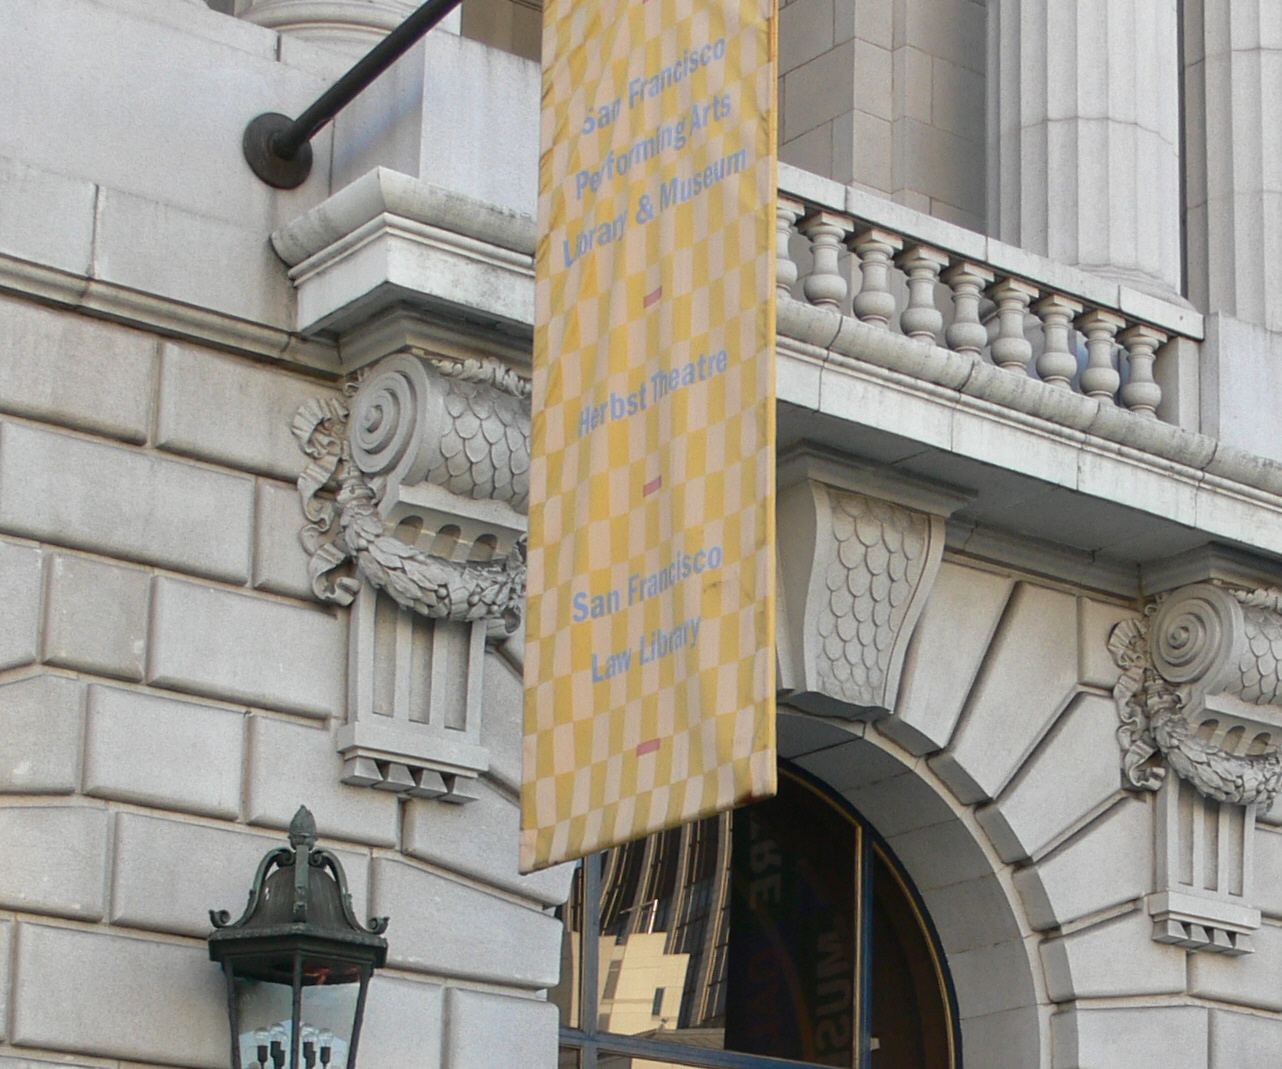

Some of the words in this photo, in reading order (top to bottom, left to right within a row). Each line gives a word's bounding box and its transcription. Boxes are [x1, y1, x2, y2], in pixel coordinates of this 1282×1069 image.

[628, 37, 725, 109] Francisco
[576, 116, 686, 199] Performing
[690, 91, 731, 131] Arts
[635, 194, 655, 225] &
[660, 148, 746, 212] Museum
[579, 386, 647, 438] Herbst
[651, 348, 728, 403] Theatre
[572, 590, 620, 622] San
[628, 546, 722, 606] Francisco
[591, 644, 632, 683] Law
[640, 616, 701, 665] Library
